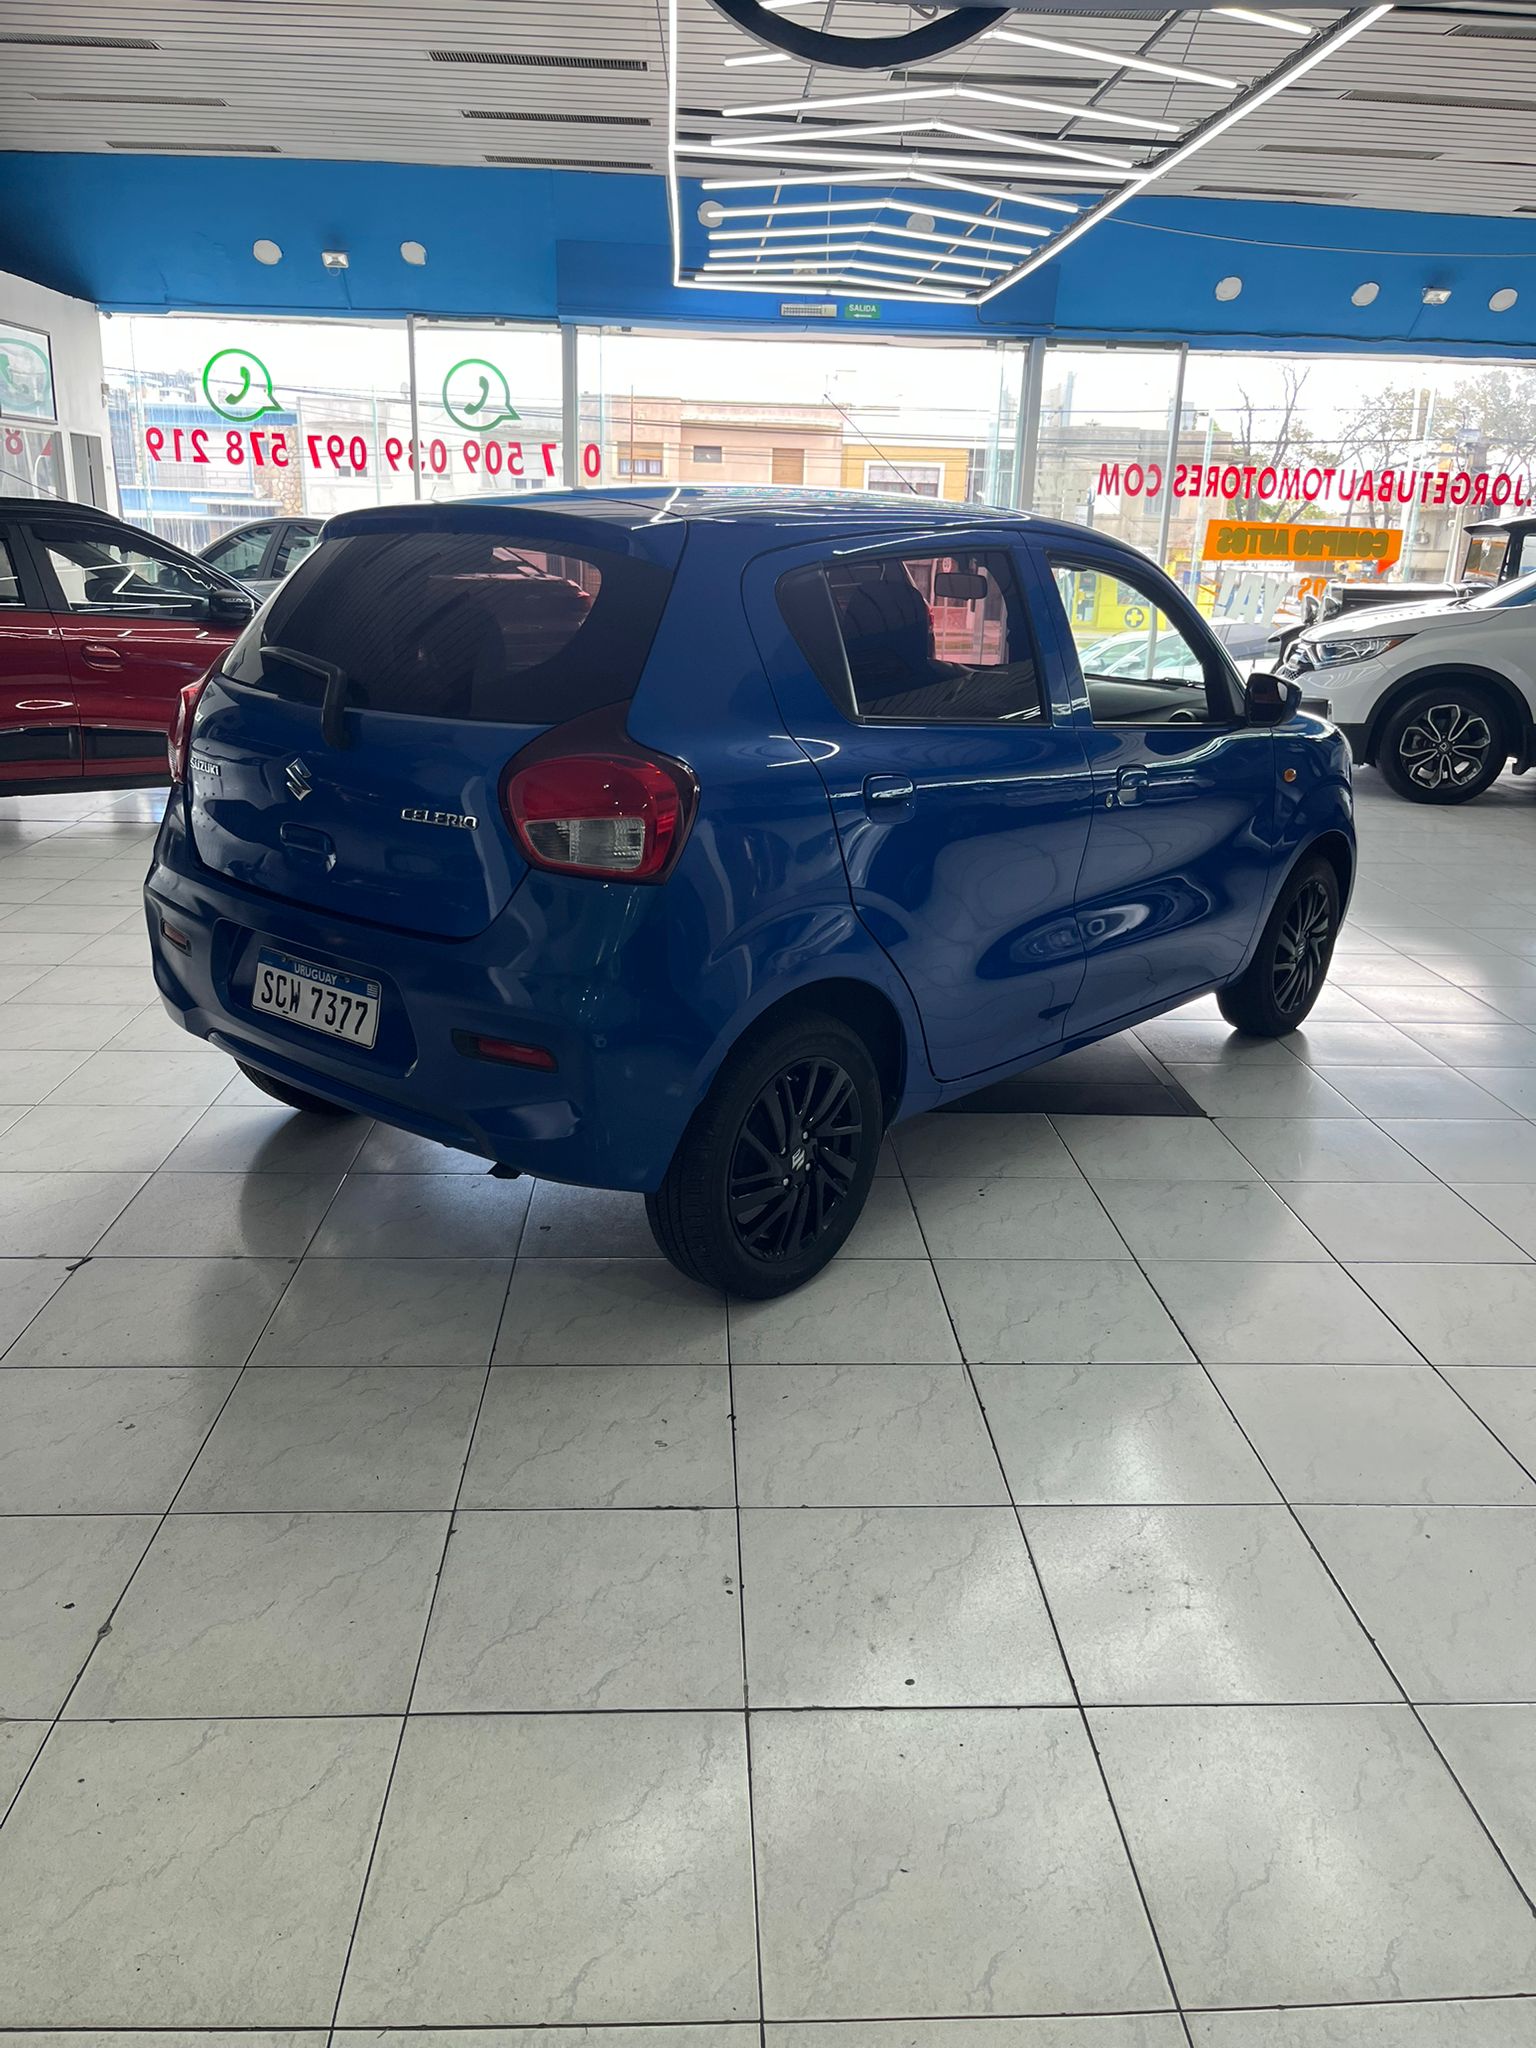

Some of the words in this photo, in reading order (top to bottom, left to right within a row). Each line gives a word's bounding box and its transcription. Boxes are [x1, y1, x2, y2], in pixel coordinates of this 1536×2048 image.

[848, 303, 877, 313] SALIDA
[190, 756, 219, 776] SUZUKI
[401, 808, 478, 831] CELERIO
[293, 962, 338, 986] URUGUAY
[311, 986, 369, 1035] 7377
